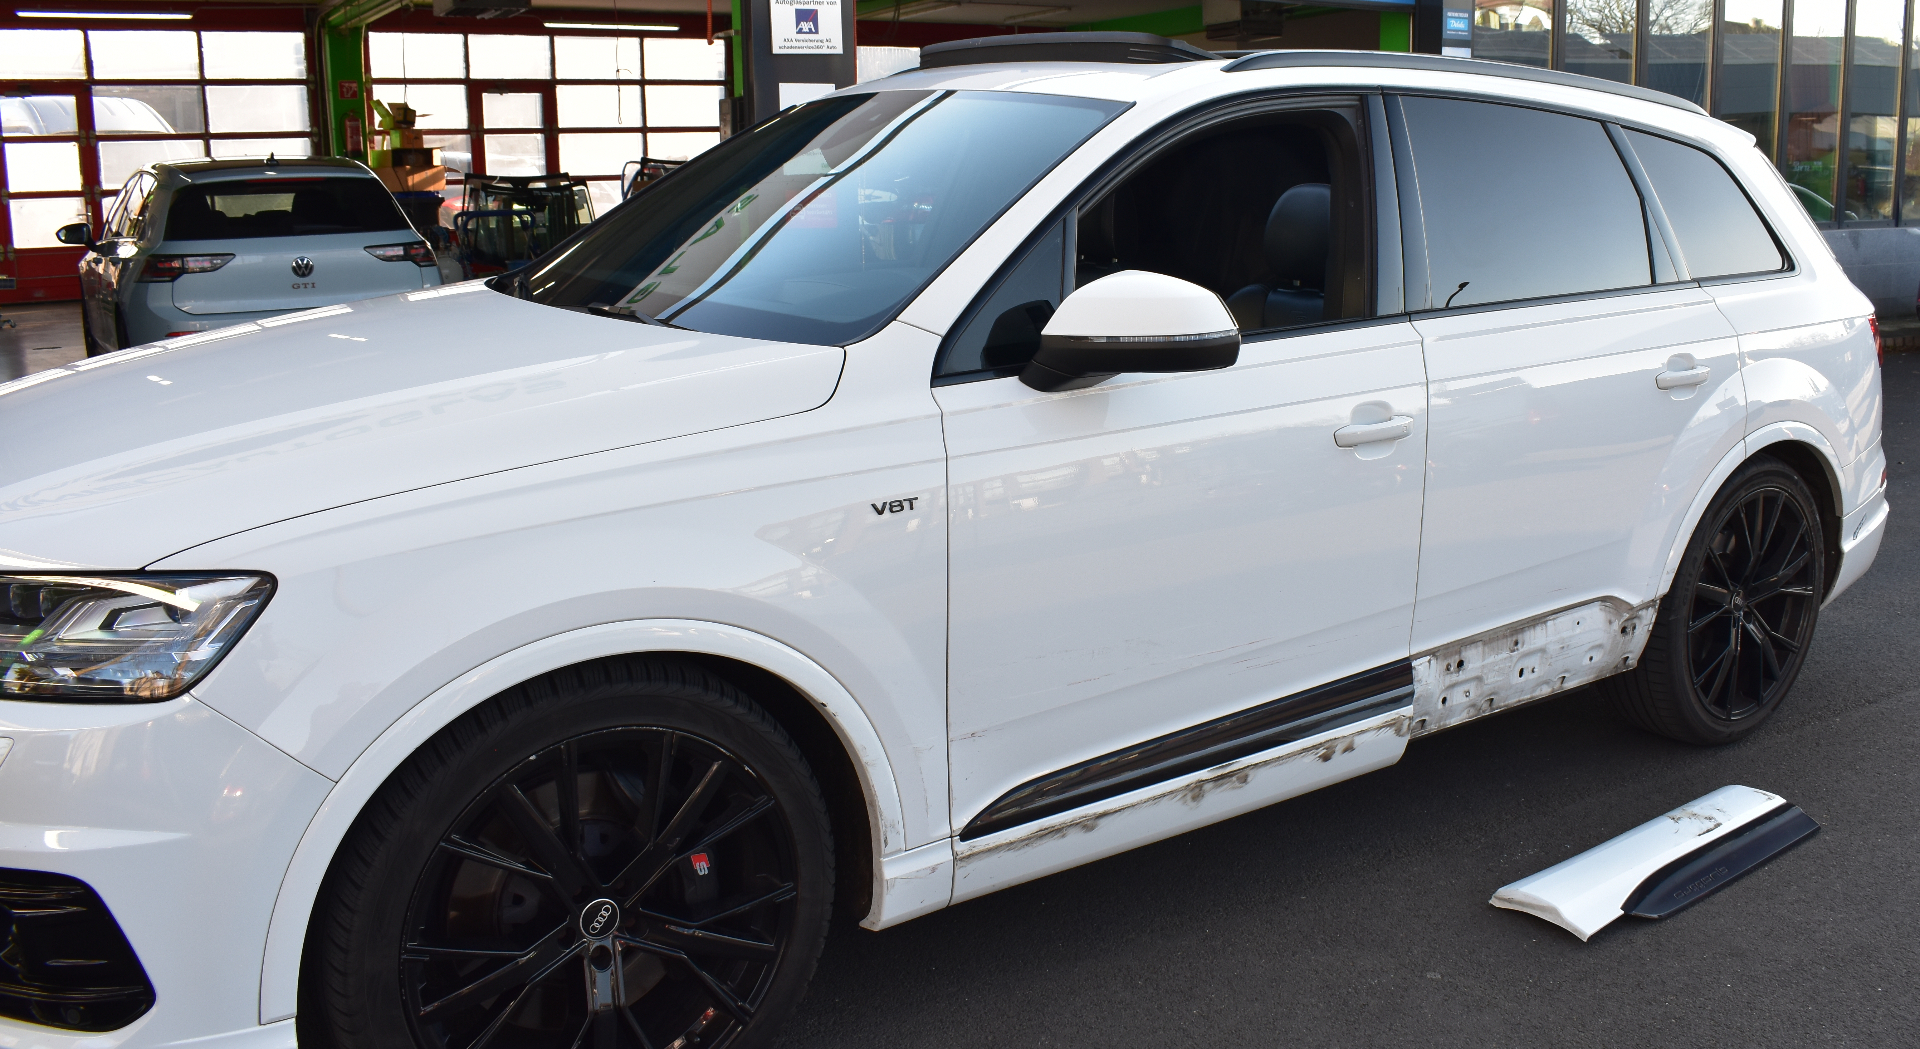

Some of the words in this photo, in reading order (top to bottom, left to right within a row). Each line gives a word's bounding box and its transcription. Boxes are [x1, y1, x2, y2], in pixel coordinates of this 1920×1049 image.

[796, 21, 816, 33] AXA
[291, 282, 317, 290] GTI
[871, 496, 919, 516] V8T
[1673, 866, 1729, 900] quattro
